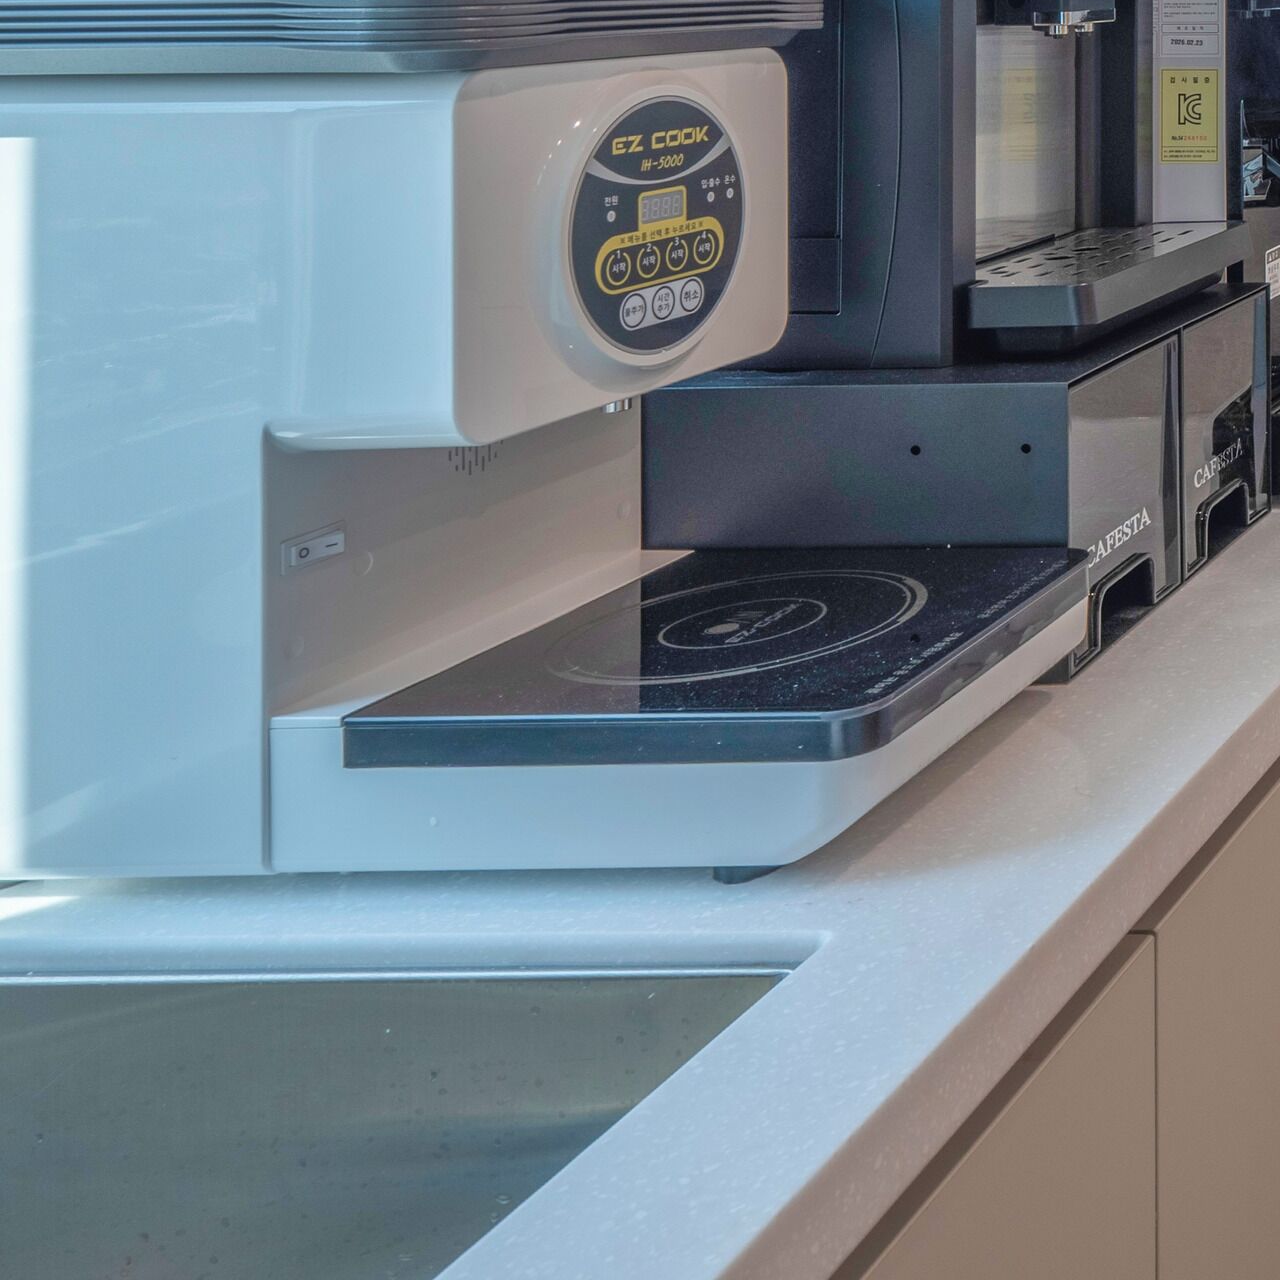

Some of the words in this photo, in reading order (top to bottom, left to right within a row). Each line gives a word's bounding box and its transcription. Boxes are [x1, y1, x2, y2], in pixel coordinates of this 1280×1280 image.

[611, 134, 644, 156] EZ
[650, 124, 711, 150] COOK
[640, 152, 684, 173] IH-5000
[604, 195, 619, 207] 전원
[701, 230, 707, 239] 4
[674, 236, 680, 246] 3
[646, 243, 653, 253] 2
[671, 248, 684, 260] 시작
[698, 242, 712, 254] 시작
[616, 250, 621, 260] 1
[642, 255, 657, 267] 시작
[611, 262, 627, 274] 시작
[656, 292, 671, 303] 시간
[683, 291, 700, 304] 취소
[1194, 437, 1244, 489] CAFESTA
